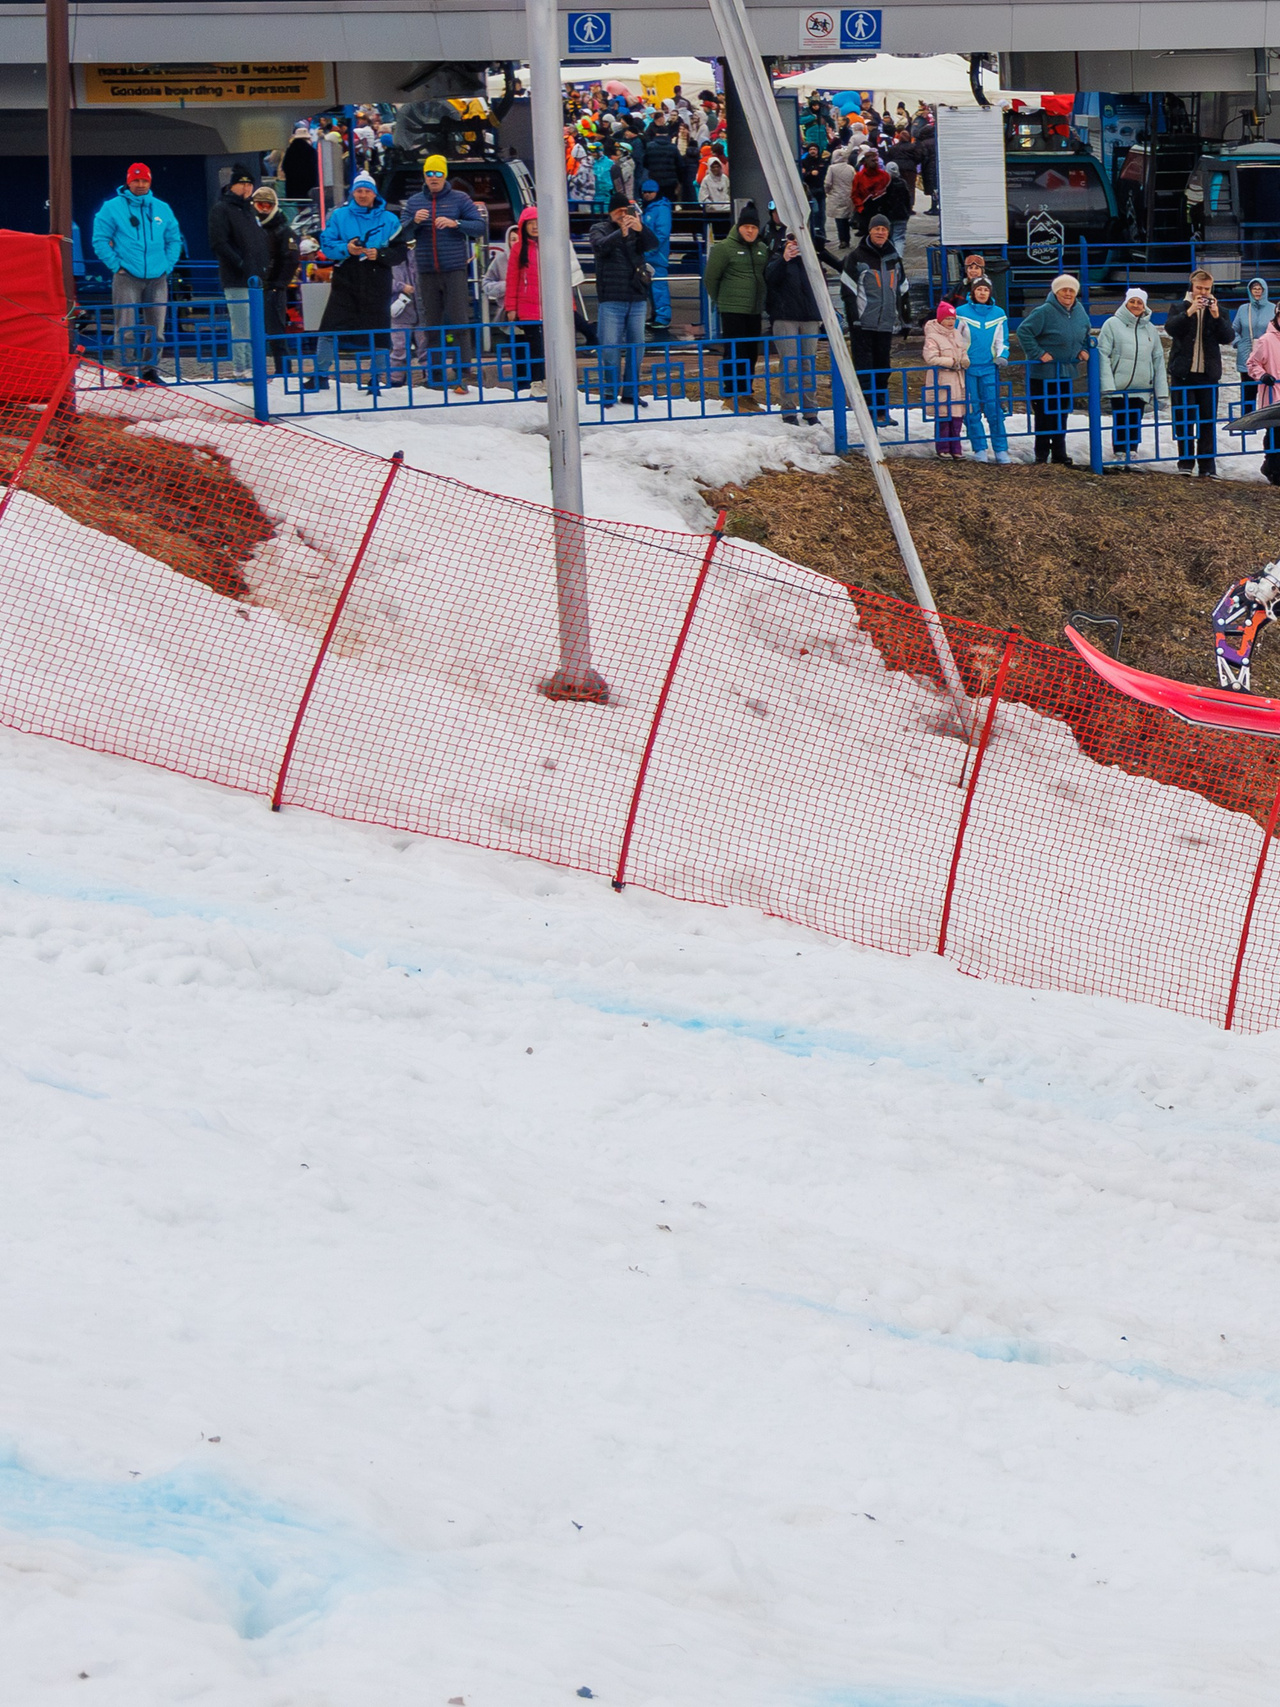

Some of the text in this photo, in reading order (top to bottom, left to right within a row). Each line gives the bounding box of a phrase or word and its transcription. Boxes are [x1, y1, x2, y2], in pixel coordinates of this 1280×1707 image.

[110, 86, 162, 96] Gondola
[164, 85, 223, 97] boarding
[248, 85, 301, 96] persons
